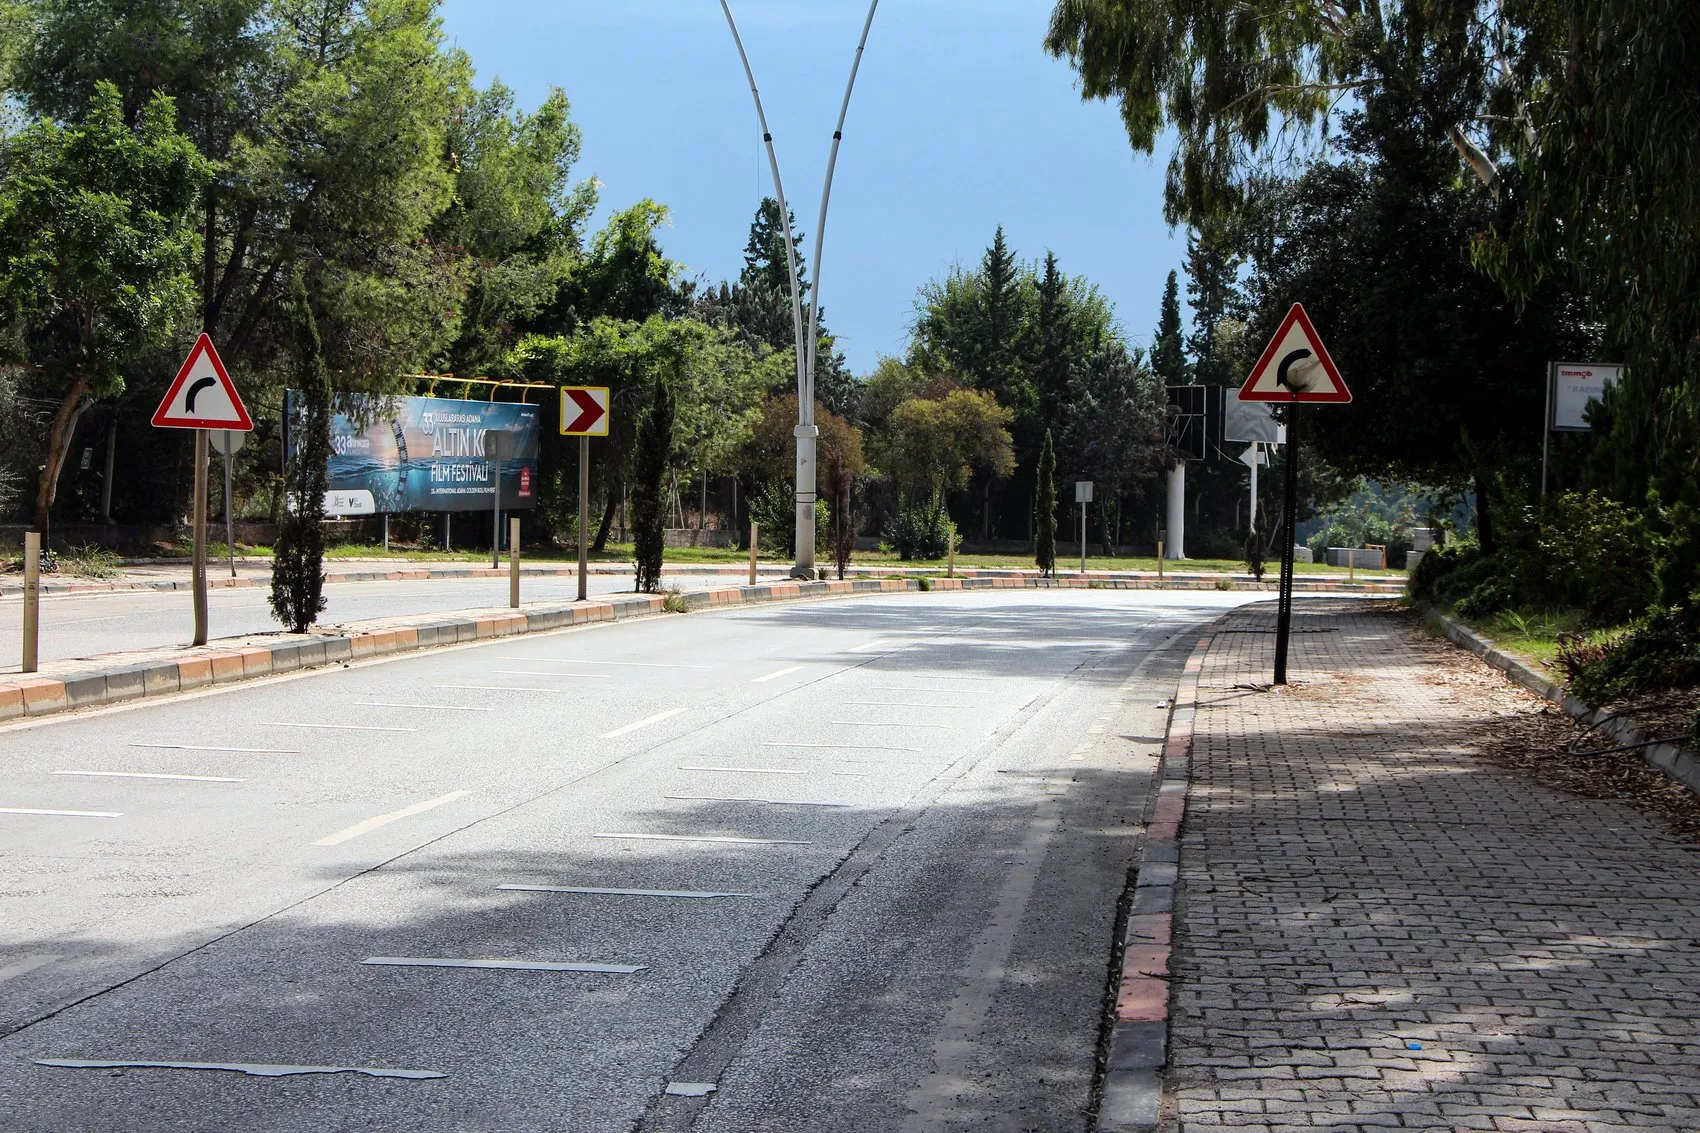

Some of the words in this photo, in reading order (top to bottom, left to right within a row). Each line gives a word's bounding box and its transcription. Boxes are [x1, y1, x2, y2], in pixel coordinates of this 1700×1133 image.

[467, 413, 481, 424] ADANA
[432, 427, 469, 457] ALTIN
[431, 460, 450, 482] FİLM
[451, 460, 489, 482] FESTİVALİ
